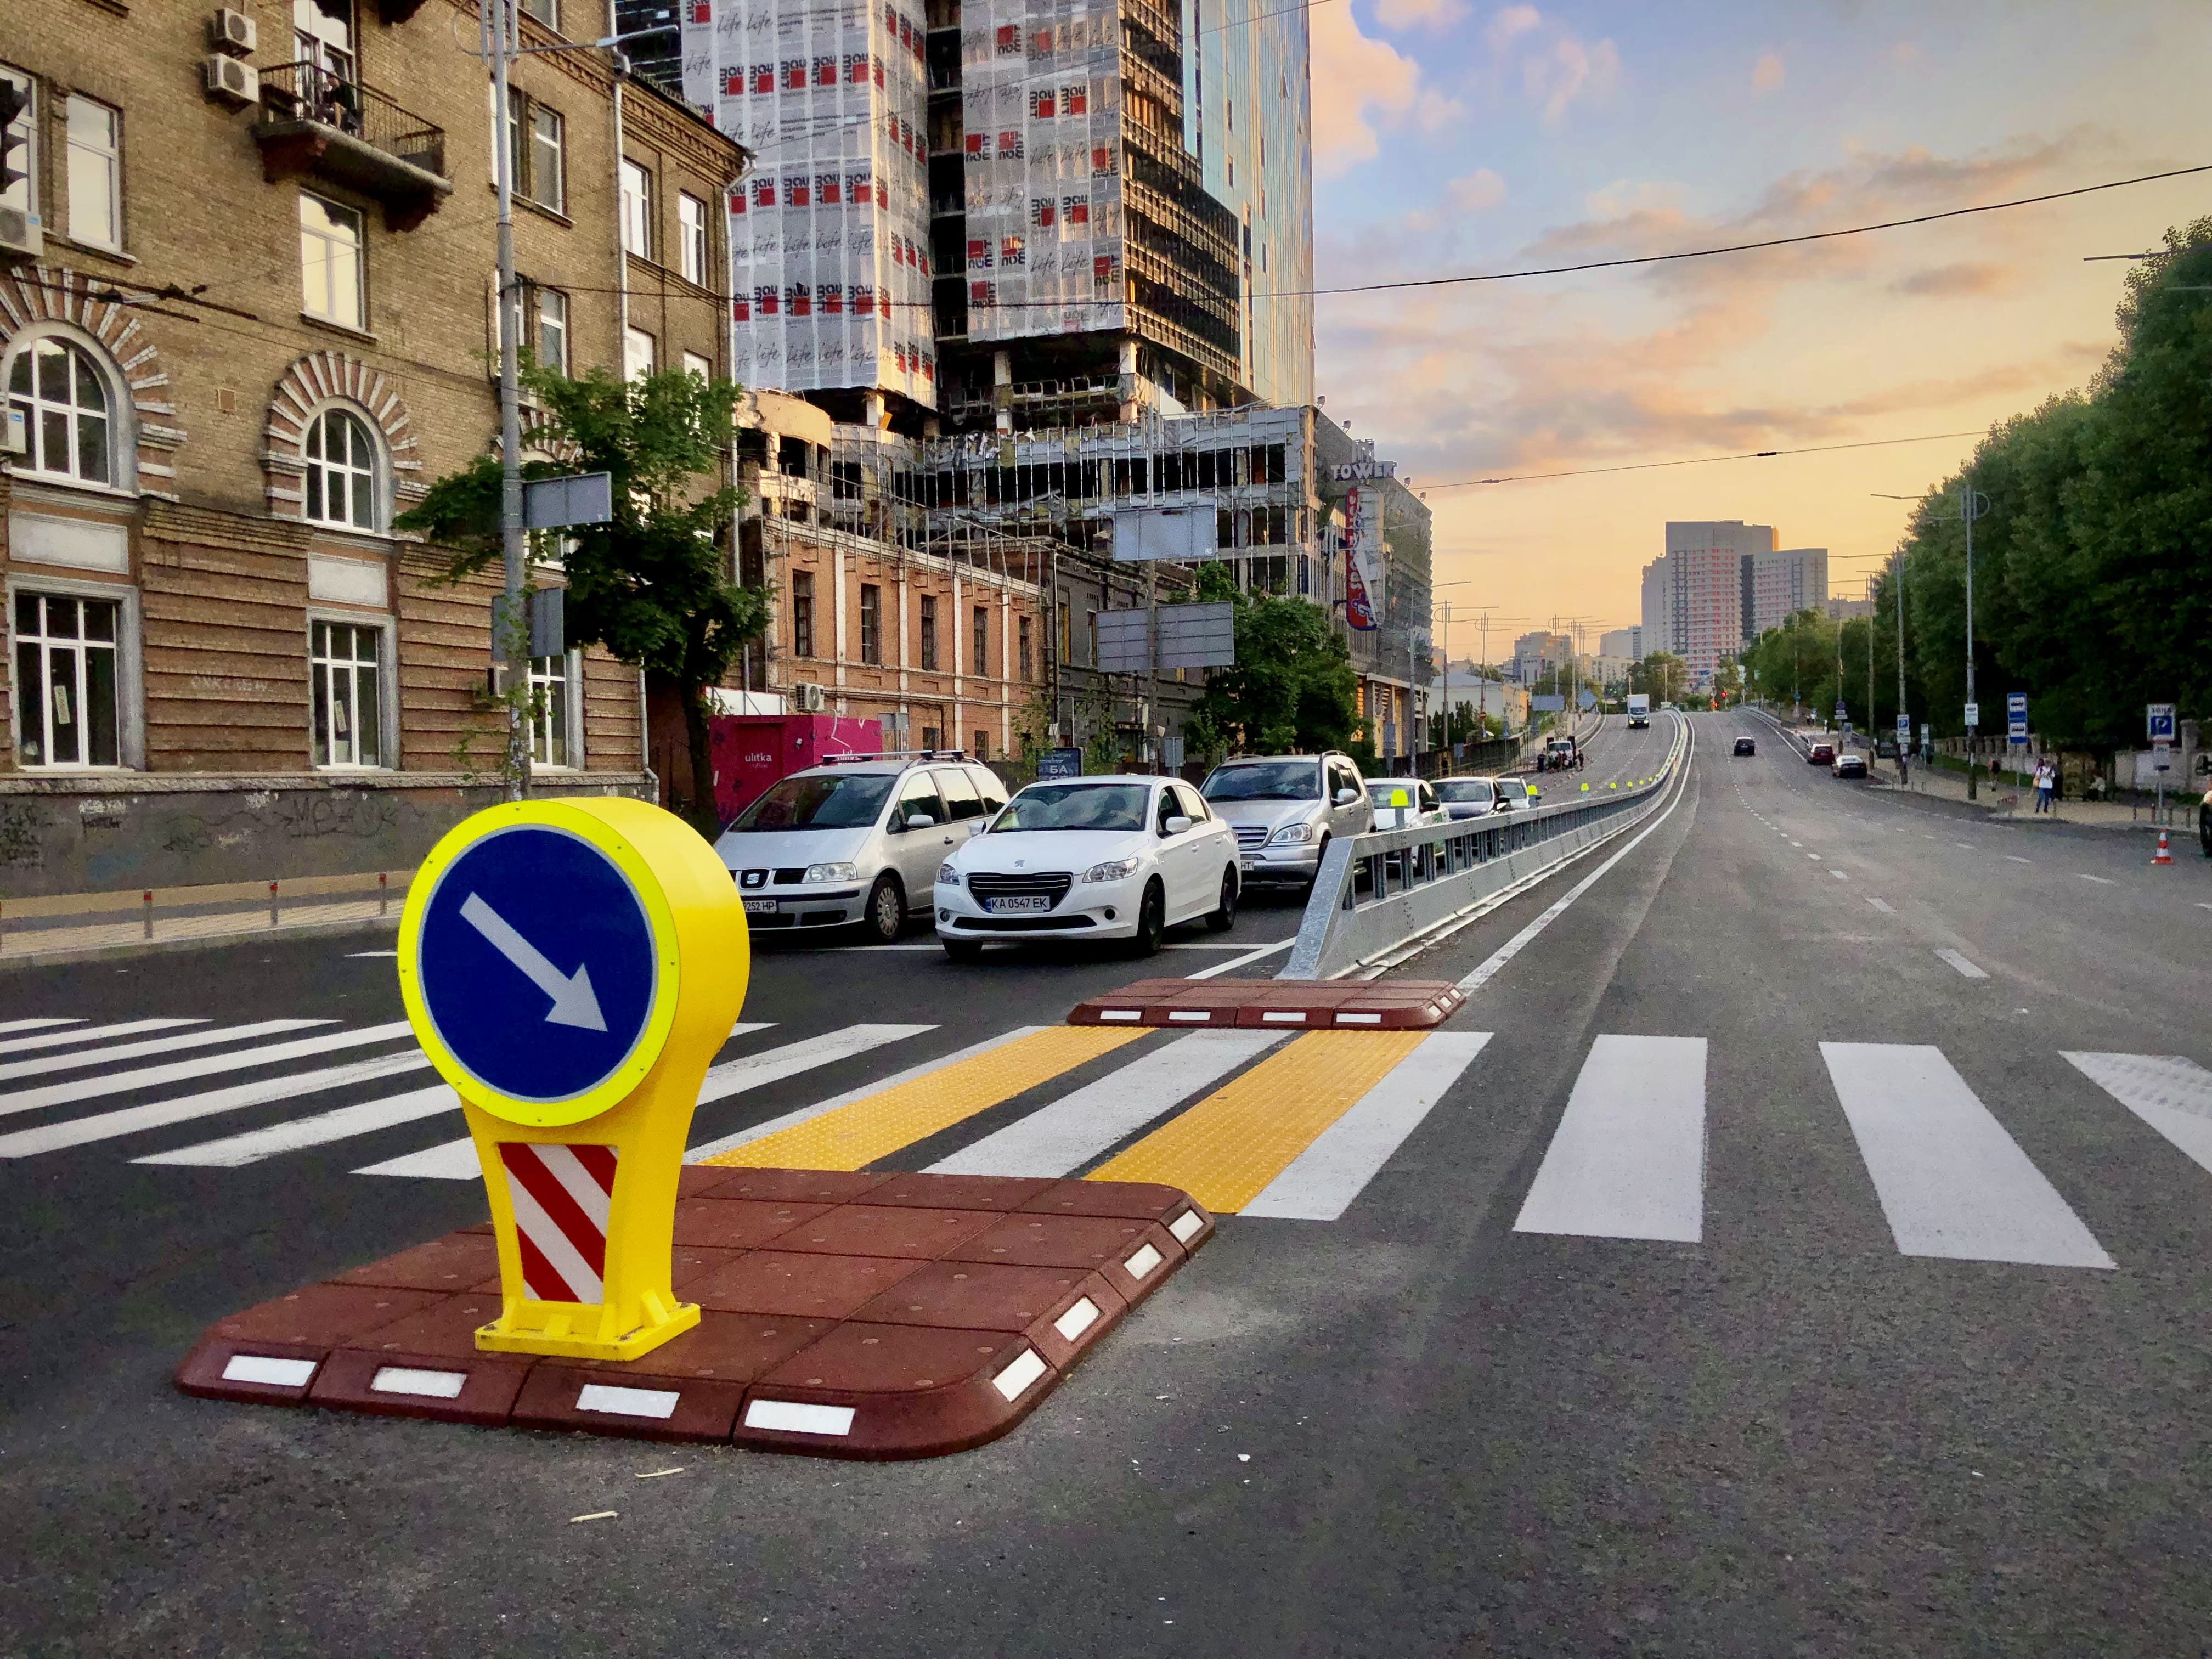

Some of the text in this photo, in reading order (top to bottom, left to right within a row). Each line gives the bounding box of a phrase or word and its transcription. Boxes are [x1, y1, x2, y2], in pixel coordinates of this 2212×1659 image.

[1330, 461, 1396, 480] TOWER
[744, 752, 772, 762] ulitka
[1049, 765, 1068, 774] БА
[762, 901, 774, 911] HP
[991, 898, 1047, 909] KA 0547 EK
